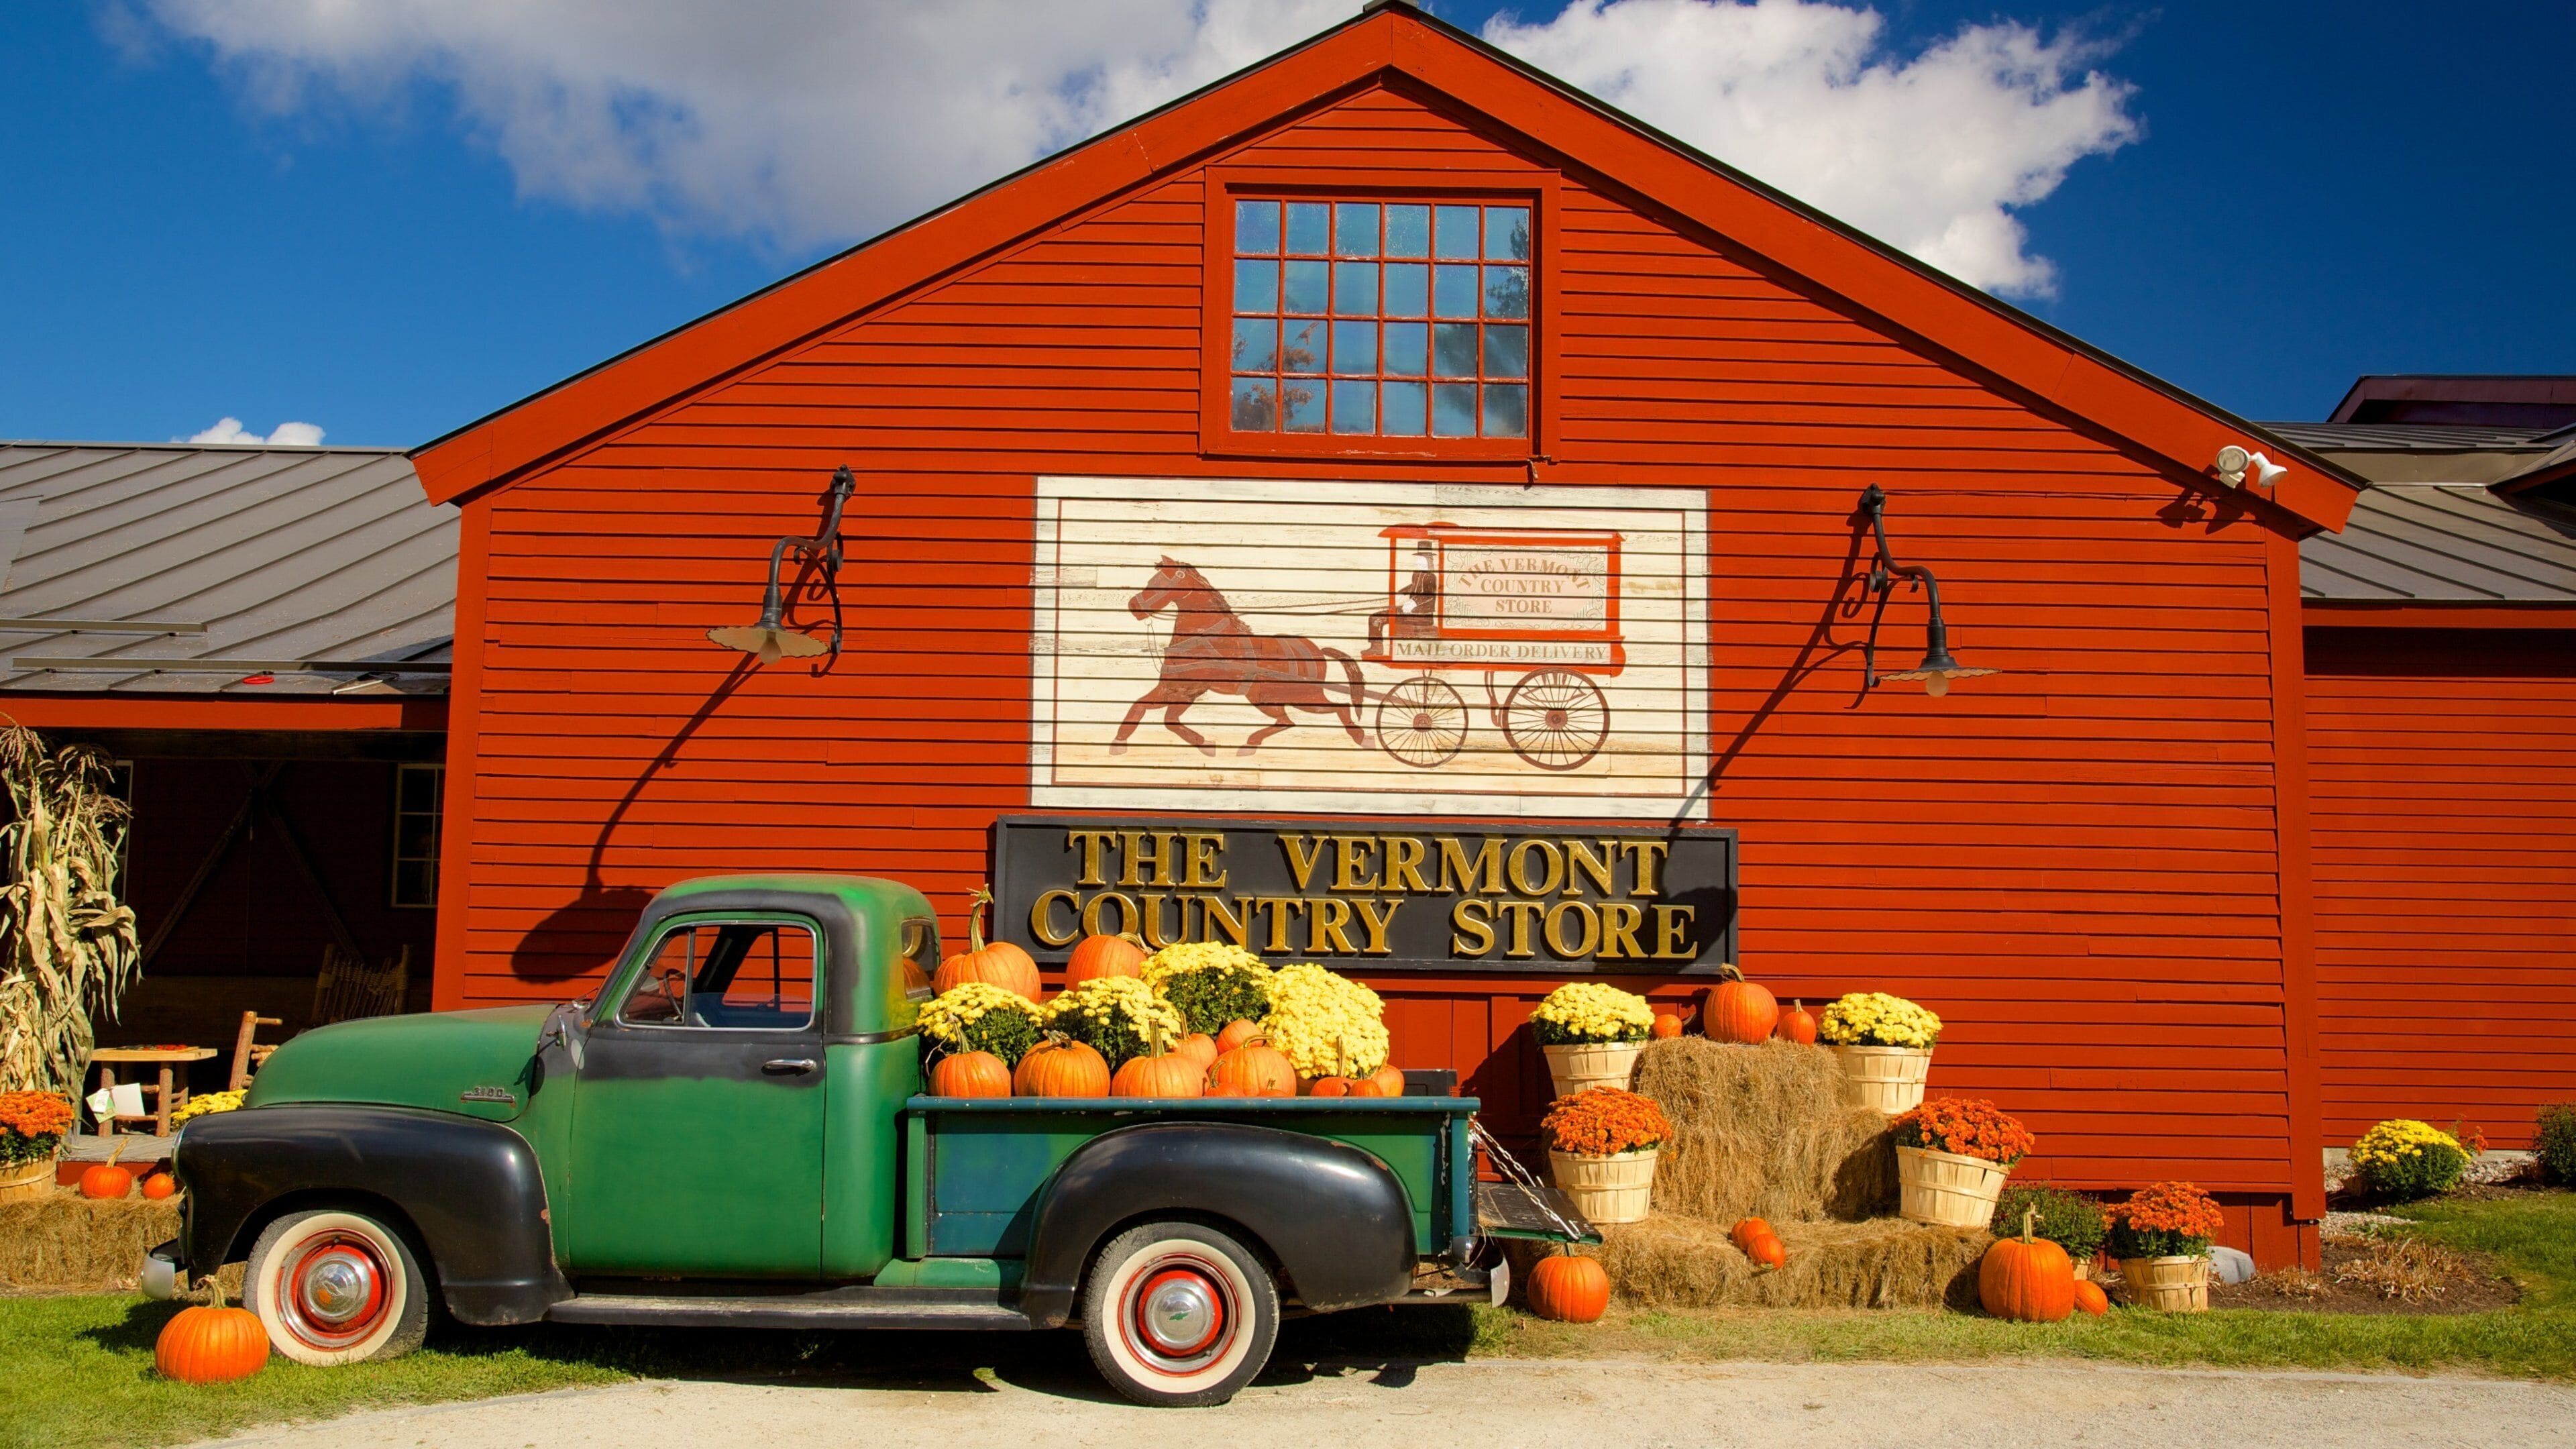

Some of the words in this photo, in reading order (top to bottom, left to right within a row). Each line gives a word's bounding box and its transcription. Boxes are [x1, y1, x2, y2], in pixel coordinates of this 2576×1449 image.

[1458, 559, 1495, 588] THE
[1500, 557, 1591, 590] VERMONT
[1481, 578, 1566, 594] COUNTRY
[1495, 598, 1552, 614] STORE
[1396, 642, 1447, 657] MAIL
[1450, 643, 1512, 657] ORDER
[1517, 645, 1607, 660] DELIVERY
[1068, 830, 1227, 888] THE
[1278, 835, 1668, 896] VERMONT
[1030, 889, 1404, 953] COUNTRY
[1452, 900, 1698, 959] STORE
